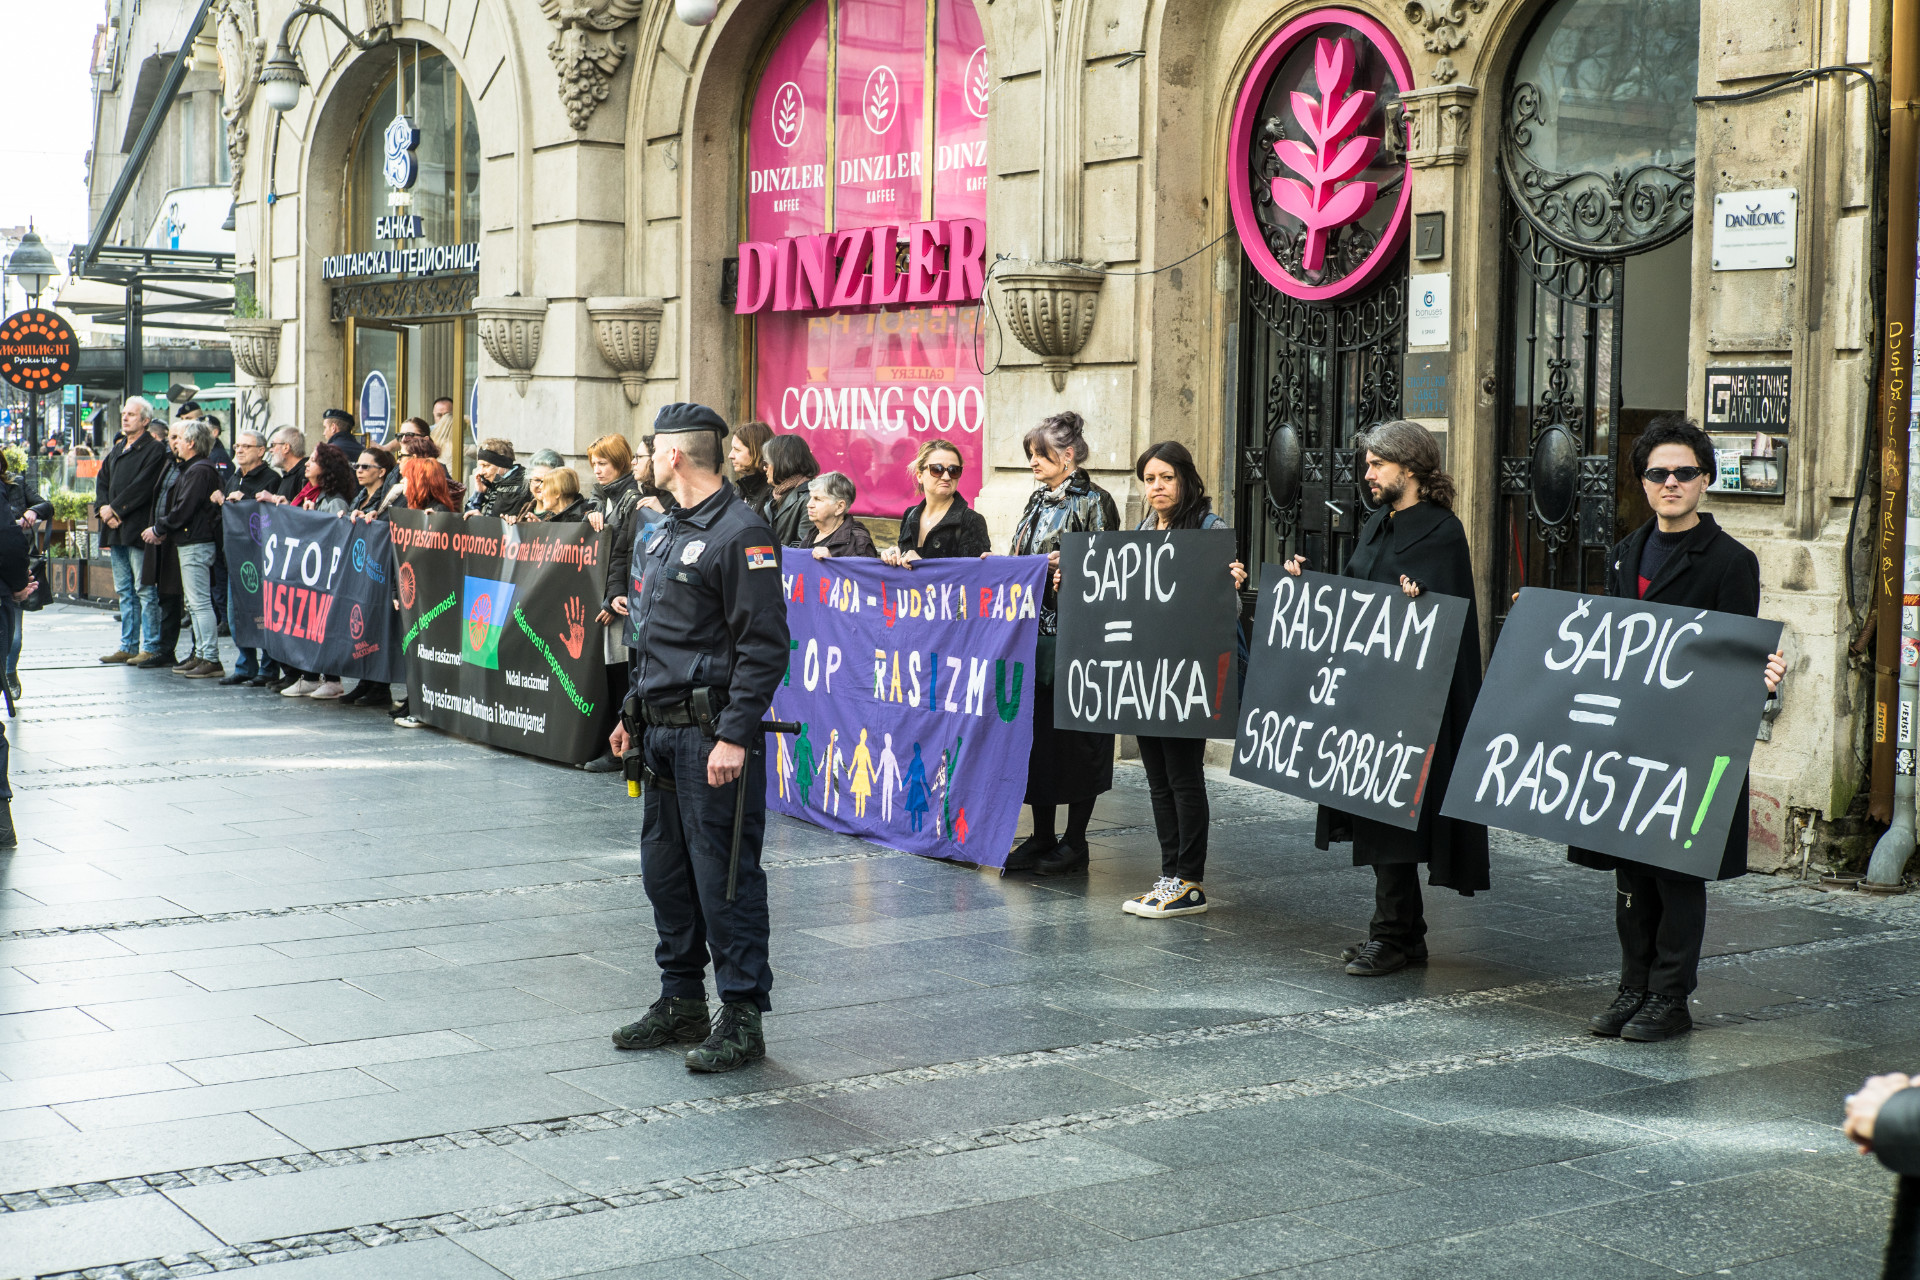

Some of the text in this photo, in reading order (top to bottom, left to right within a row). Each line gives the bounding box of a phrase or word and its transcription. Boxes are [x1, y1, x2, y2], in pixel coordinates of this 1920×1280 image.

[750, 163, 825, 194] DINZLER
[840, 151, 922, 185] DINZLER
[773, 198, 800, 213] KAFFEE
[866, 188, 896, 204] KAFFEE
[375, 214, 416, 240] БАНКА
[1424, 226, 1435, 250] 7
[322, 242, 481, 279] ПОШТАНСКА ШТЕДИОНИЦА
[734, 217, 987, 315] DINZLER
[1415, 308, 1443, 317] bonuses
[1730, 374, 1789, 396] NEKRETNINE
[780, 385, 906, 432] COMING
[263, 533, 342, 590] STOP
[390, 521, 411, 552] Stop
[412, 524, 449, 551] rasizmo
[499, 534, 531, 562] Roma
[551, 537, 599, 573] Romnja!
[1082, 531, 1177, 603] ŠAPIĆ
[819, 576, 860, 613] RASA
[979, 584, 1036, 622] RASA
[1267, 576, 1440, 670] RASIZAM
[1544, 598, 1708, 690] ŠAPIĆ
[421, 683, 434, 711] Stop
[434, 685, 463, 712] rasizmu
[494, 701, 499, 724] i
[505, 669, 550, 692] Ndal racizmin!
[873, 648, 1024, 724] RASIZMU
[1067, 651, 1232, 723] OSTAVKA!
[1309, 656, 1347, 706] JE
[1238, 708, 1435, 818] SRCE SRBIJE!
[1475, 733, 1731, 850] RASISTA!
